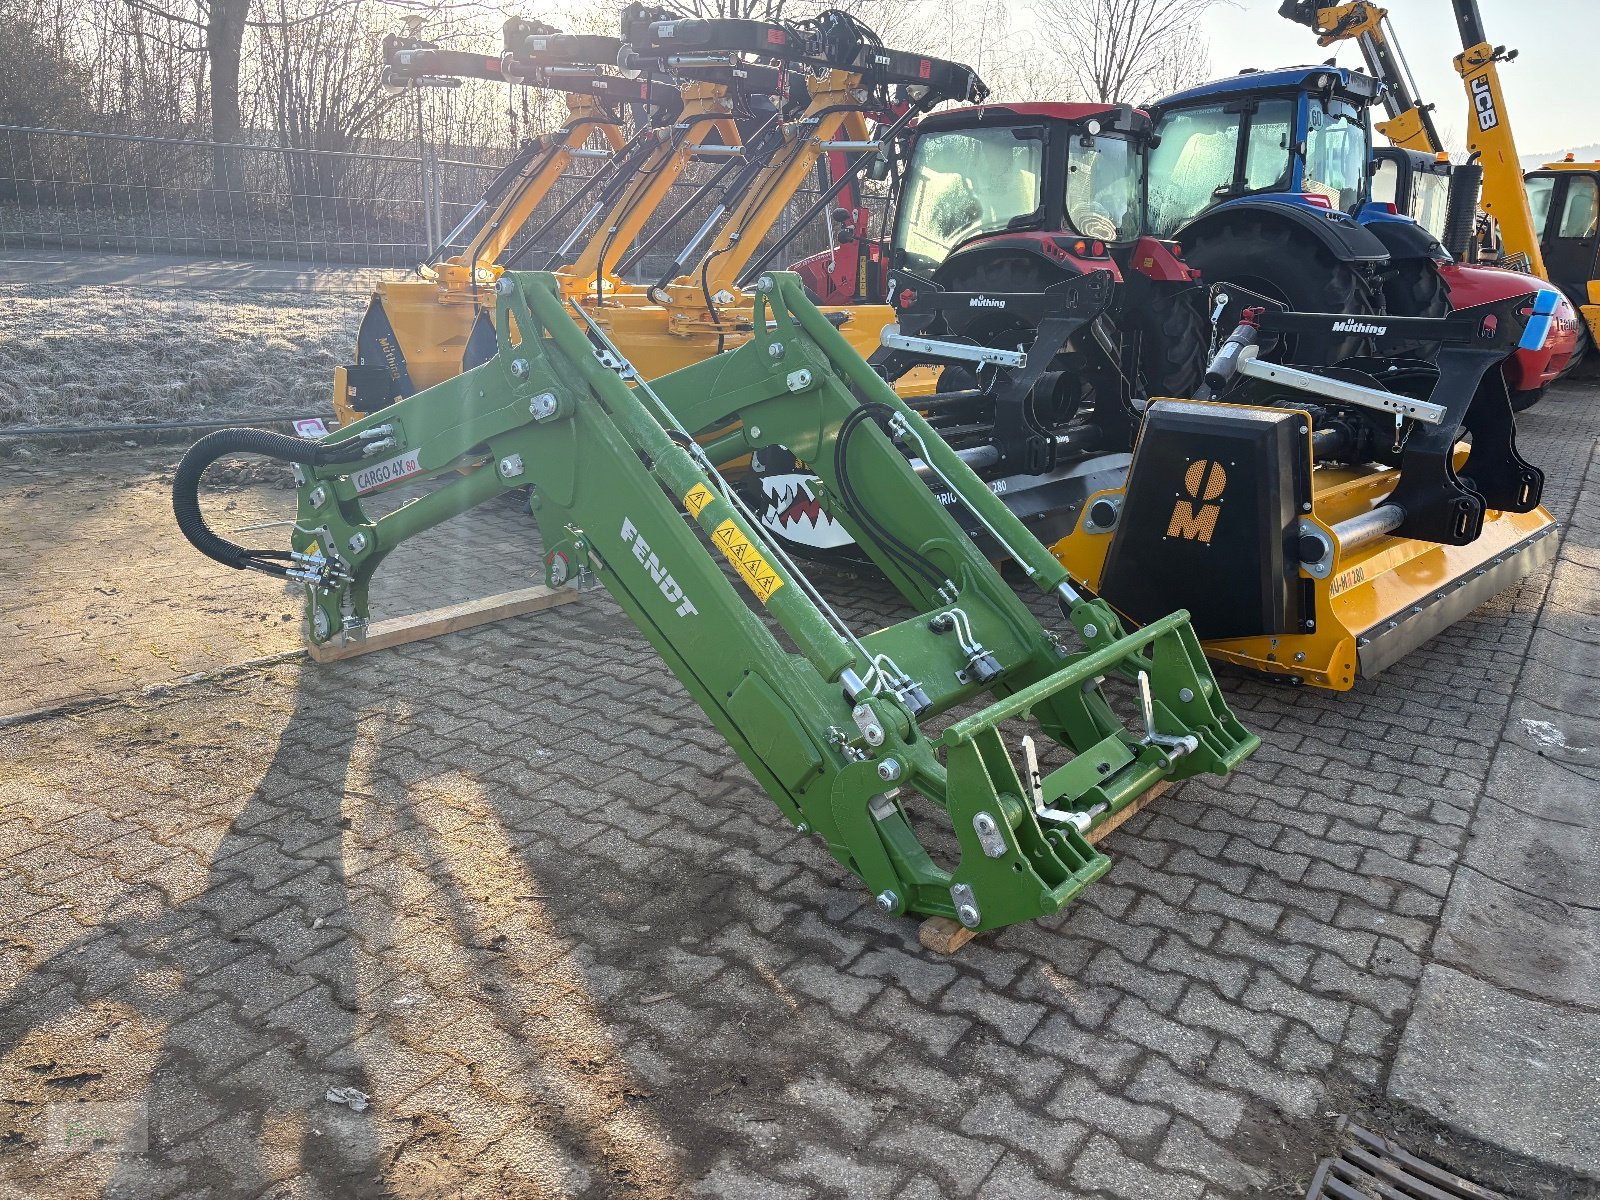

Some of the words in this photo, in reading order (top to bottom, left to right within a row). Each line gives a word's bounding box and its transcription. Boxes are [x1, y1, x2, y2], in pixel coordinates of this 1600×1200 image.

[1471, 78, 1497, 130] JCB
[1311, 109, 1322, 126] 60
[969, 294, 1006, 309] Müthing
[1331, 318, 1388, 336] Müthing
[357, 465, 391, 489] CARGO
[392, 459, 406, 477] 4X
[405, 459, 416, 472] 80
[934, 491, 957, 506] ARIO
[992, 480, 1007, 493] 280
[620, 516, 699, 618] FENDT
[1351, 566, 1365, 585] 280
